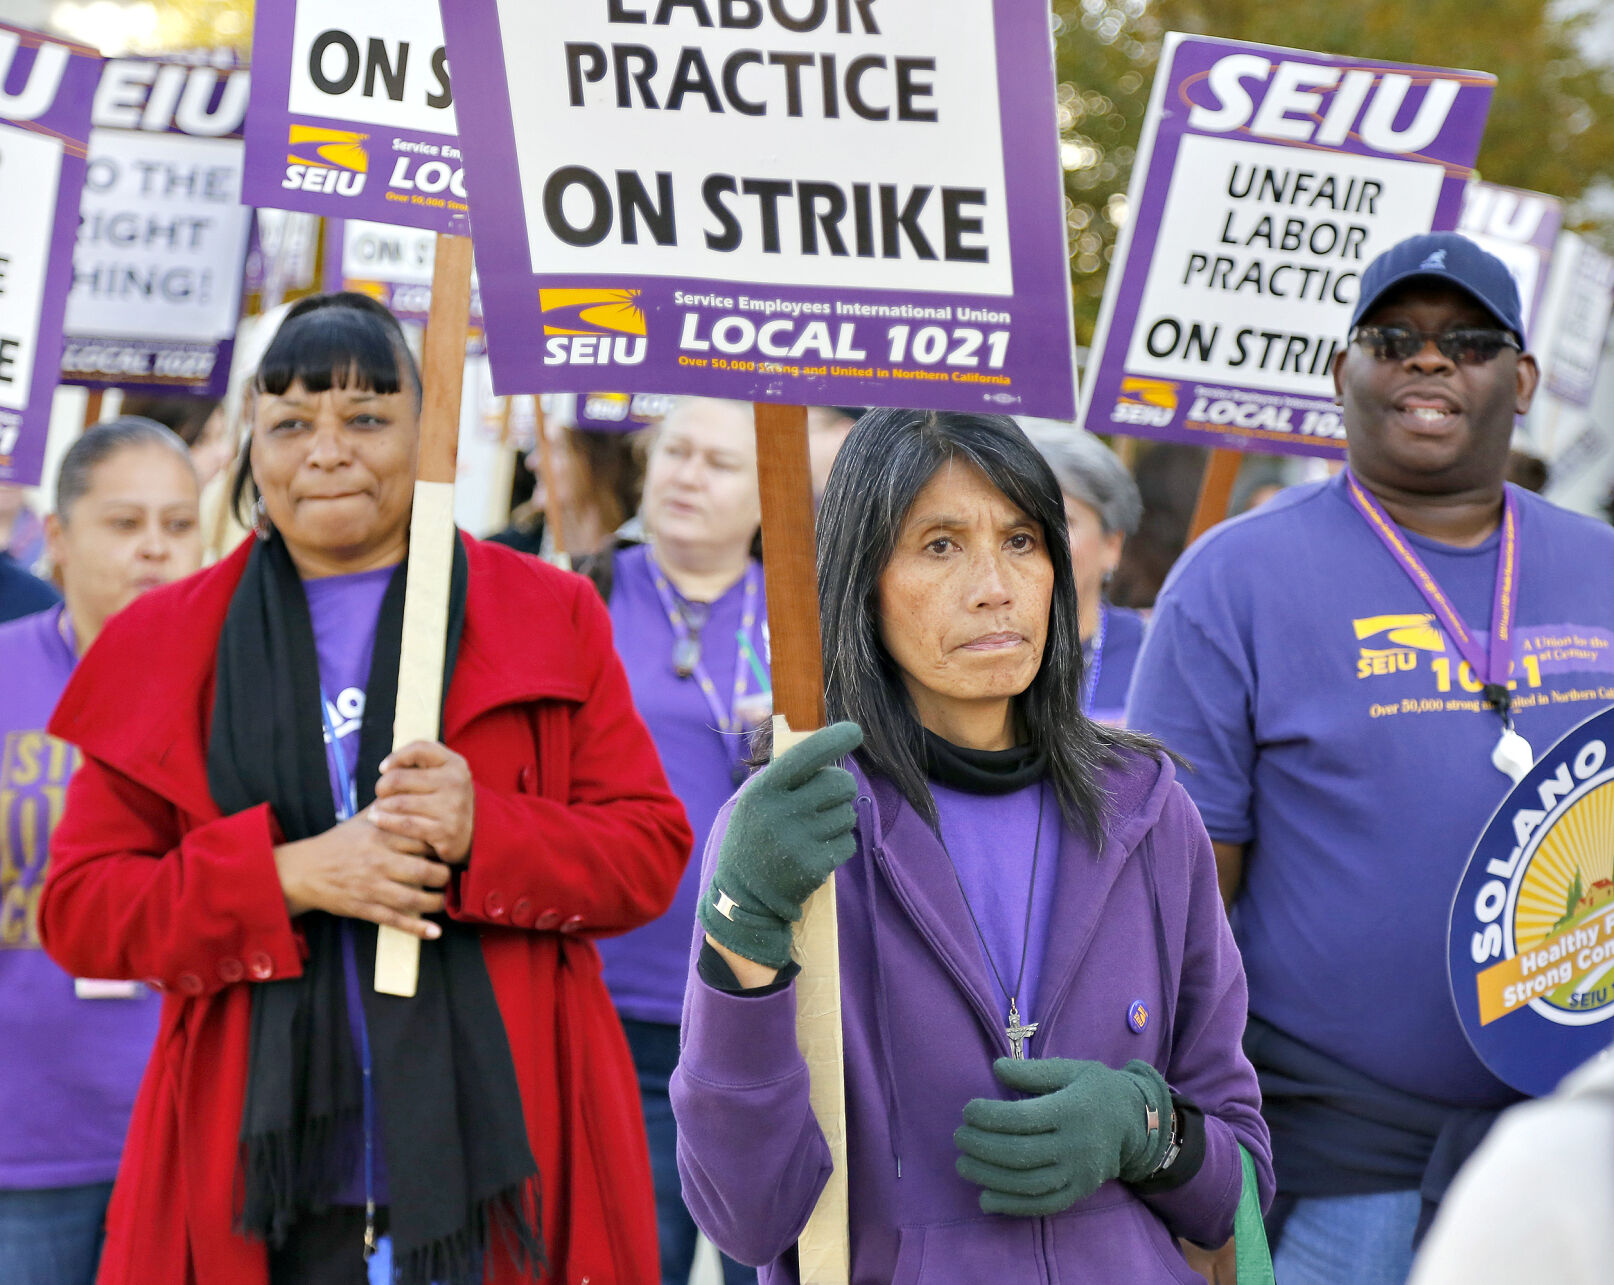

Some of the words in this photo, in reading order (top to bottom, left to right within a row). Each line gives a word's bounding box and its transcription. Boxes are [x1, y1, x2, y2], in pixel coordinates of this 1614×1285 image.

[309, 30, 409, 102] ON
[564, 41, 939, 123] PRACTICE
[91, 59, 251, 136] EIU
[1188, 54, 1461, 154] SEIU
[392, 137, 440, 156] Service
[86, 158, 121, 193] O
[131, 160, 236, 202] THE
[281, 164, 367, 197] SEIU
[385, 191, 409, 202] Over
[388, 156, 468, 198] LOC
[1227, 164, 1384, 214] UNFAIR
[78, 211, 213, 248] IGHT
[543, 164, 678, 248] ON
[701, 172, 990, 264] STRIKE
[1457, 180, 1548, 244] IU
[1219, 210, 1369, 260] LABOR
[73, 261, 213, 303] HING!
[1181, 254, 1362, 305] PRACTIC
[674, 291, 734, 308] Service
[738, 296, 831, 318] Employees
[836, 301, 952, 320] International
[957, 307, 1011, 323] Union
[543, 336, 647, 366] SEIU
[679, 312, 867, 361] LOCAL
[888, 325, 1011, 368] 1021
[1146, 318, 1219, 362] ON
[1228, 328, 1338, 377] STRI
[678, 355, 708, 367] Over
[711, 358, 755, 371] 50,000
[803, 366, 827, 376] and
[830, 366, 873, 377] United
[876, 368, 889, 378] in
[892, 369, 949, 381] Northern
[951, 371, 1012, 385] California
[1111, 402, 1177, 428] SEIU
[1187, 397, 1293, 433] LOCAL
[1356, 651, 1418, 680] SEIU
[1370, 703, 1400, 718] Over
[1401, 698, 1443, 714] 50,000
[1446, 699, 1480, 713] strong
[1509, 694, 1537, 709] nited
[1538, 692, 1550, 706] in
[1551, 686, 1597, 704] Northern
[1471, 739, 1607, 964] SOLANO
[1521, 924, 1600, 976] Healthy
[1503, 960, 1573, 1008] Strong
[1569, 987, 1607, 1009] SEIU
